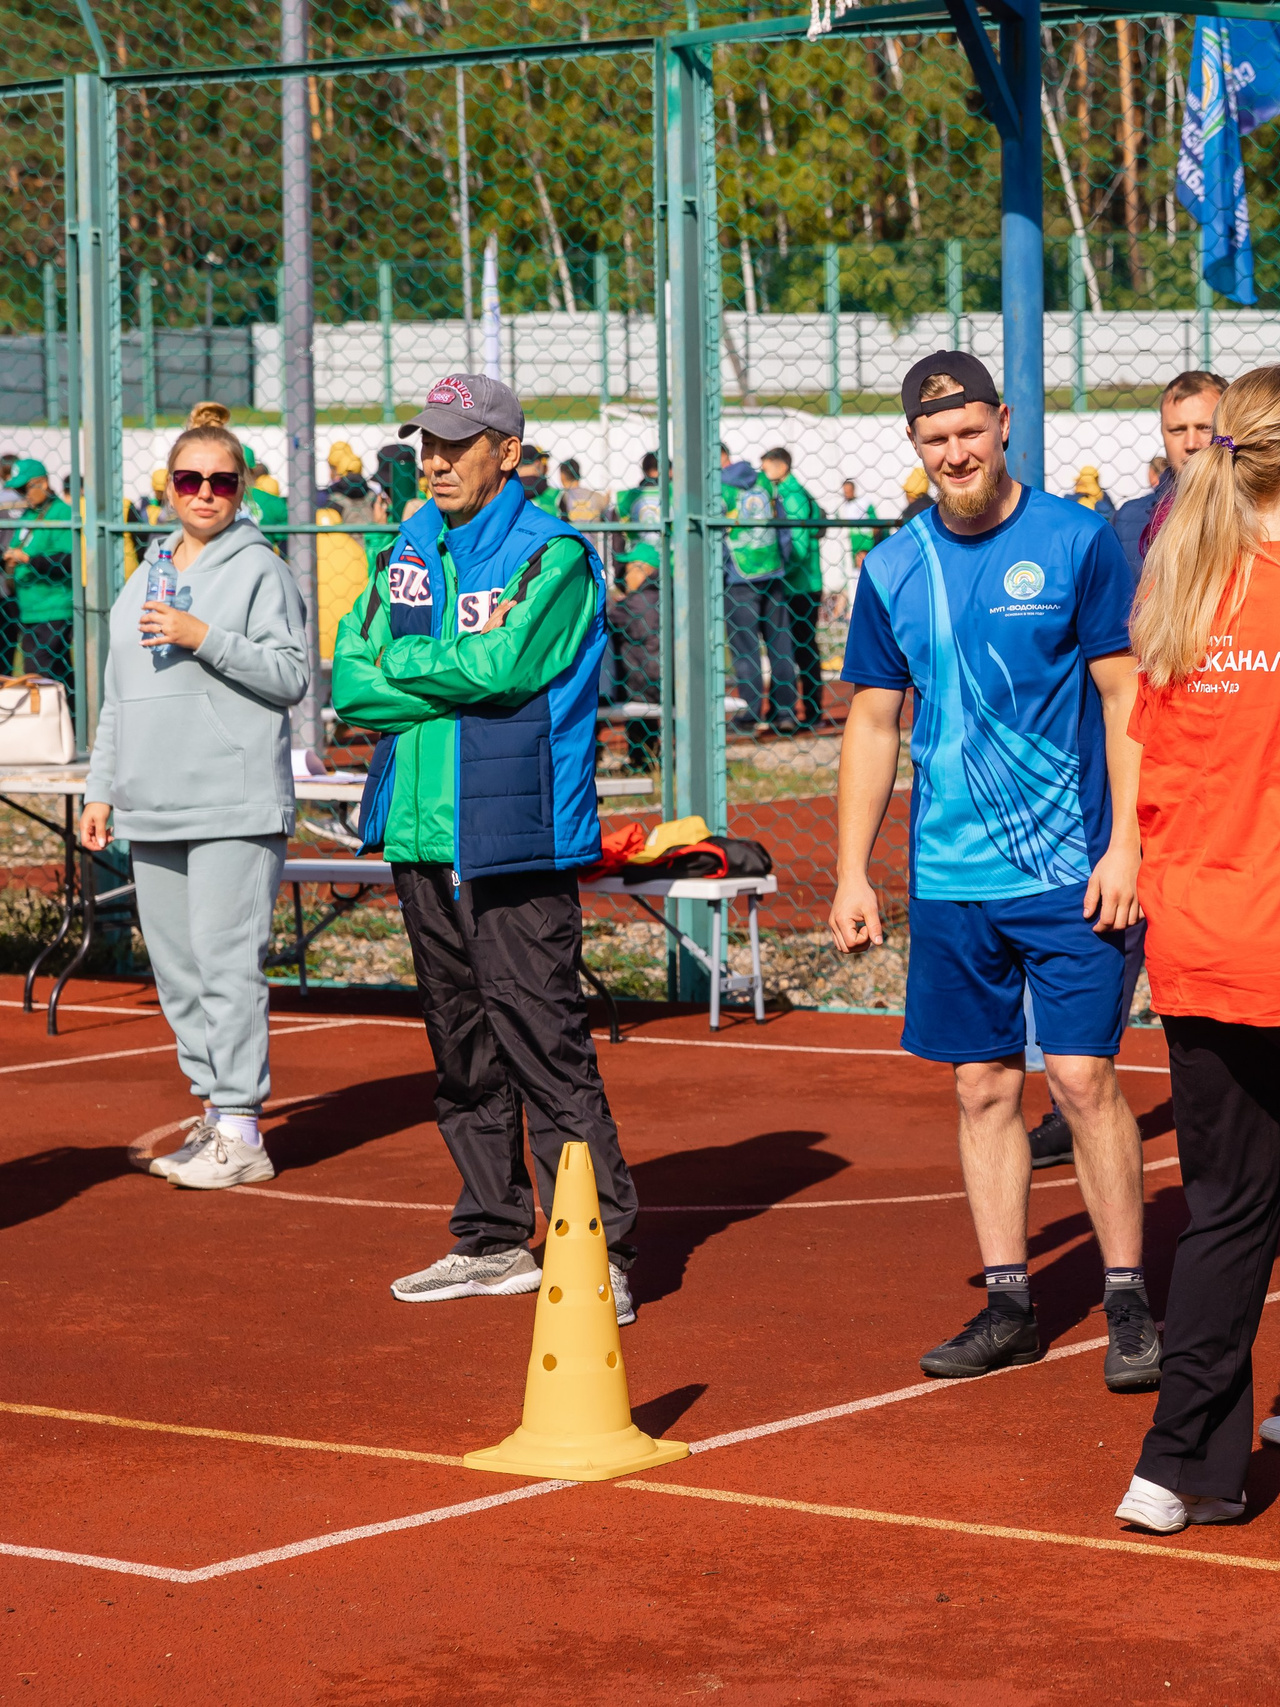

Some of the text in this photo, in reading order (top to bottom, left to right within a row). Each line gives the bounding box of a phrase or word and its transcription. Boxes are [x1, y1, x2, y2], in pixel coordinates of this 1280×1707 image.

[989, 605, 1006, 614] МУП
[1187, 680, 1240, 694] г.Улан-Удэ
[995, 1275, 1028, 1284] FILA
